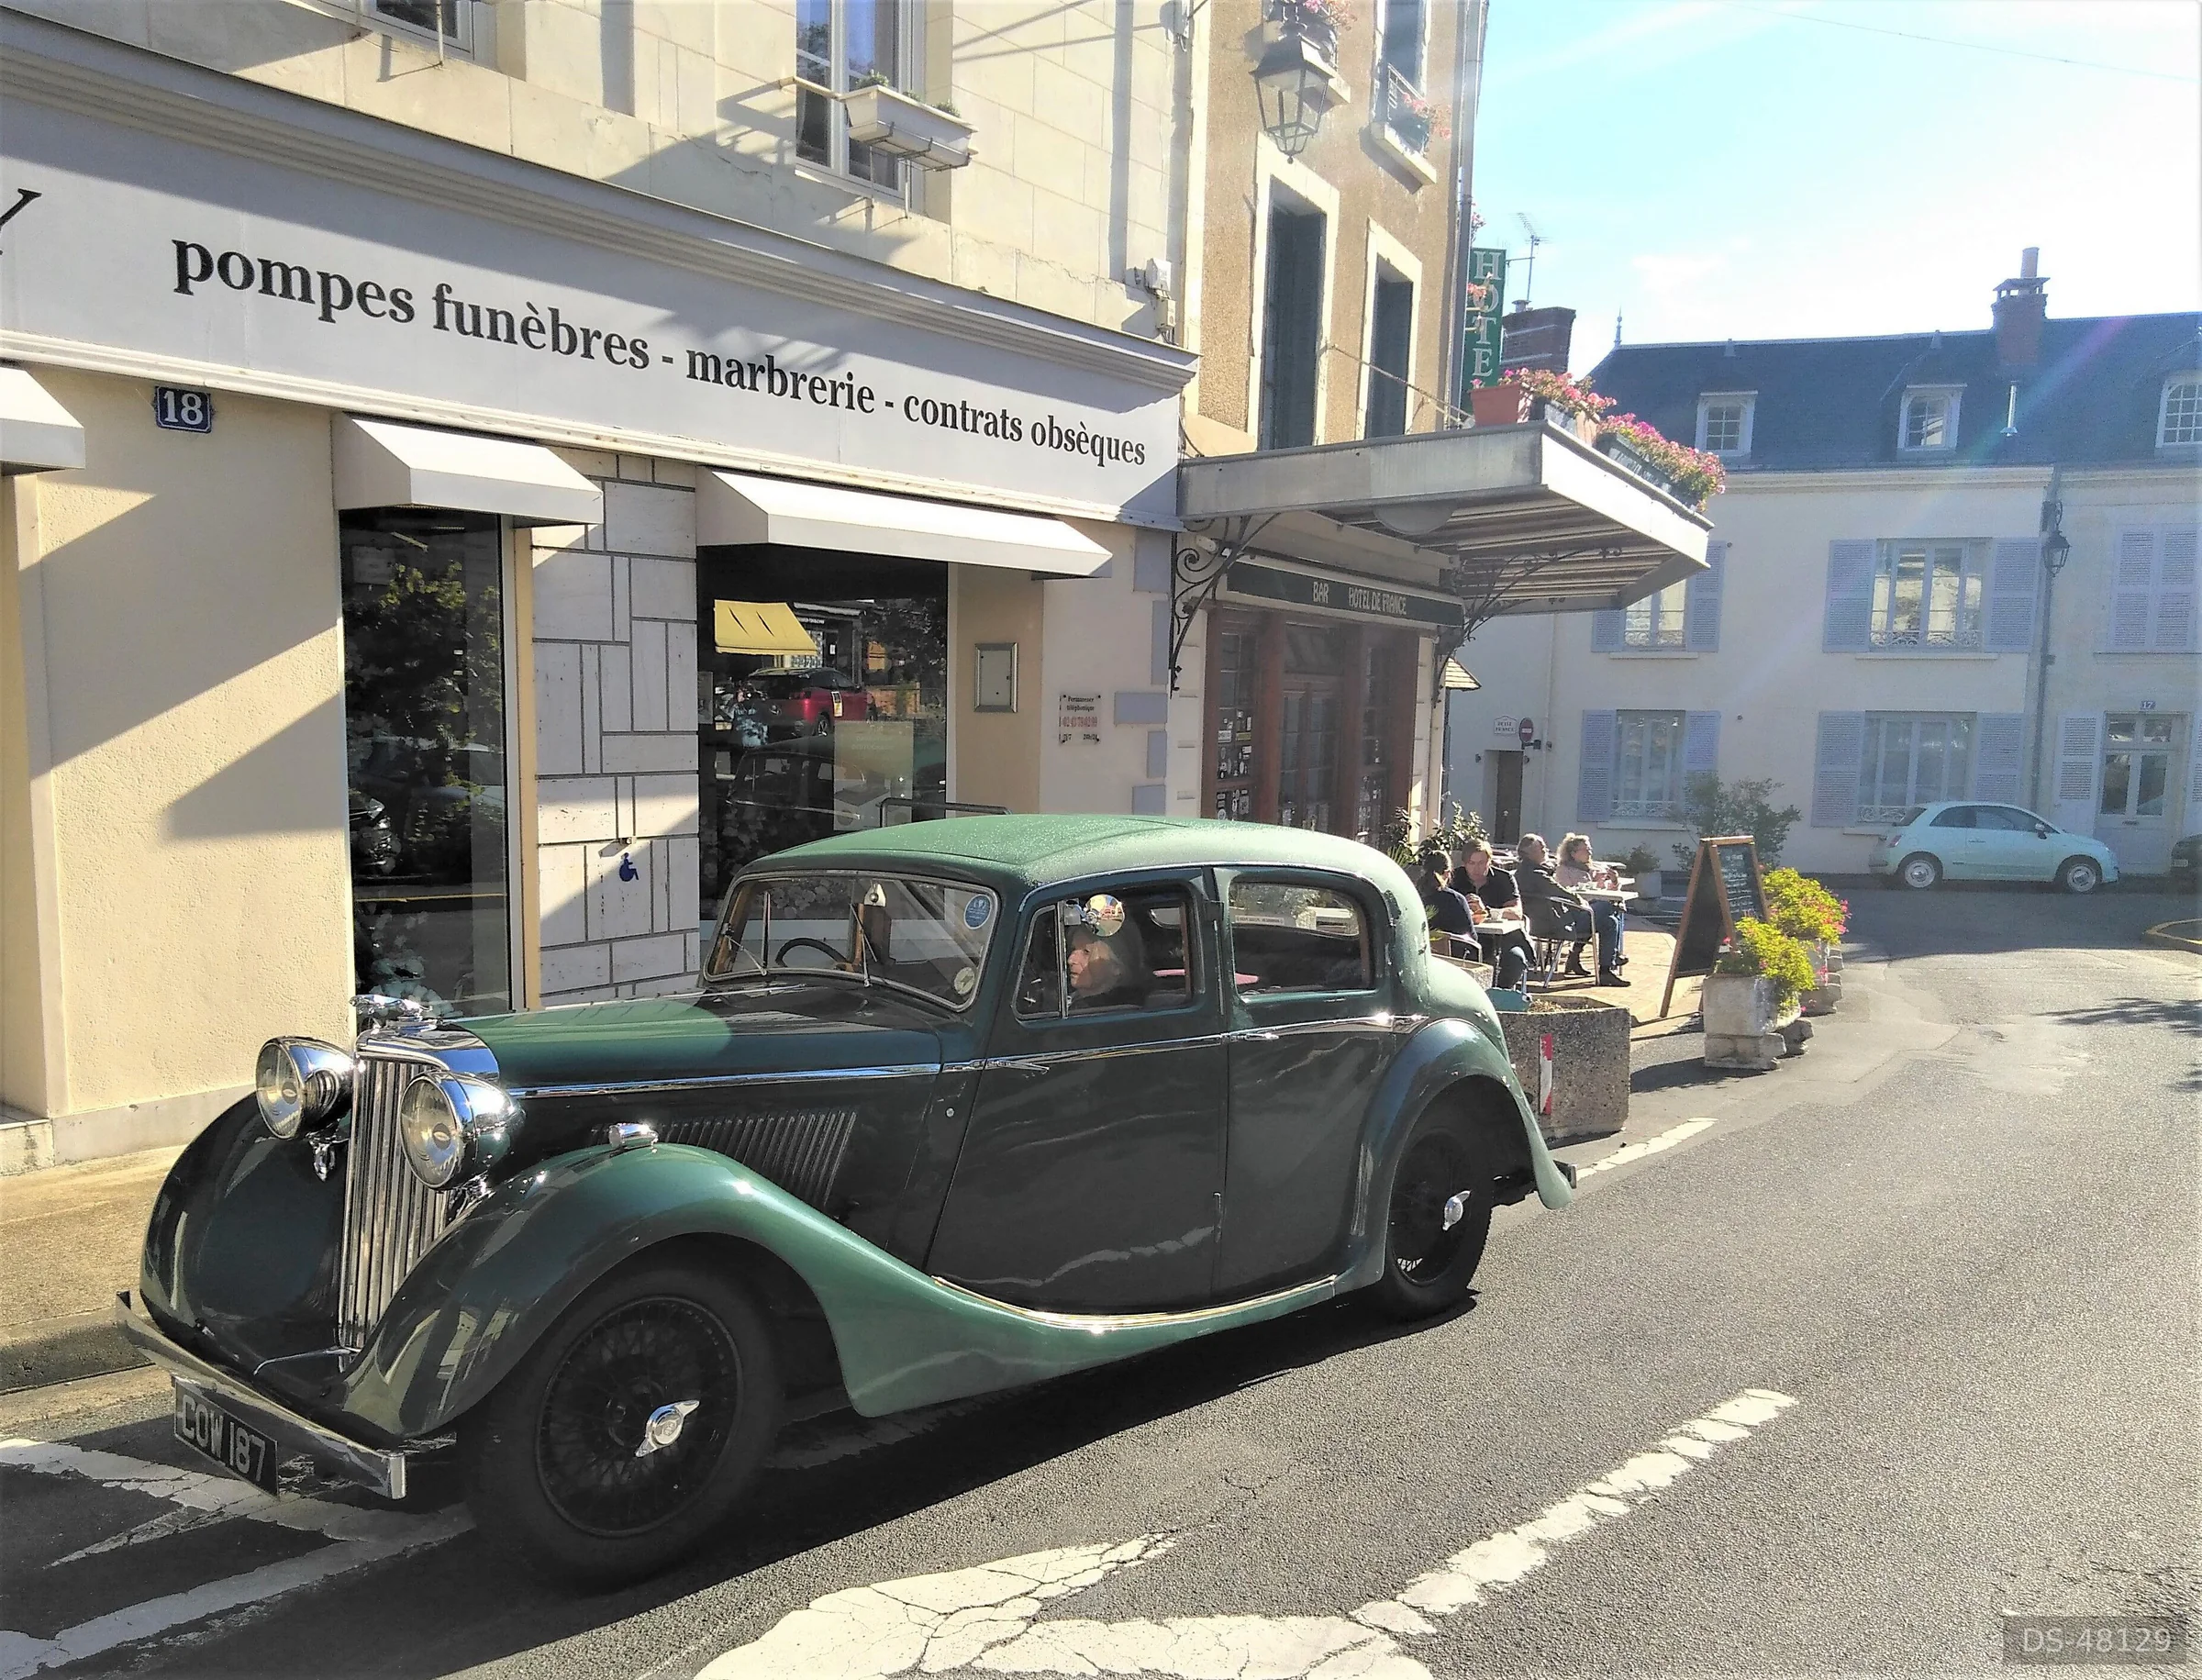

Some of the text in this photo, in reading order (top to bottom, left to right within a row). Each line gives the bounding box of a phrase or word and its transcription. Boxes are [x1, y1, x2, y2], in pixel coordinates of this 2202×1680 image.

[1472, 250, 1502, 377] HOTE
[172, 239, 1146, 468] pompes funèbres - marbrerie - contrats obsèques
[164, 390, 204, 426] 18
[1312, 581, 1329, 605] BAR
[1348, 586, 1407, 616] HOTEL DE FRANCE
[183, 1394, 266, 1483] COW 187
